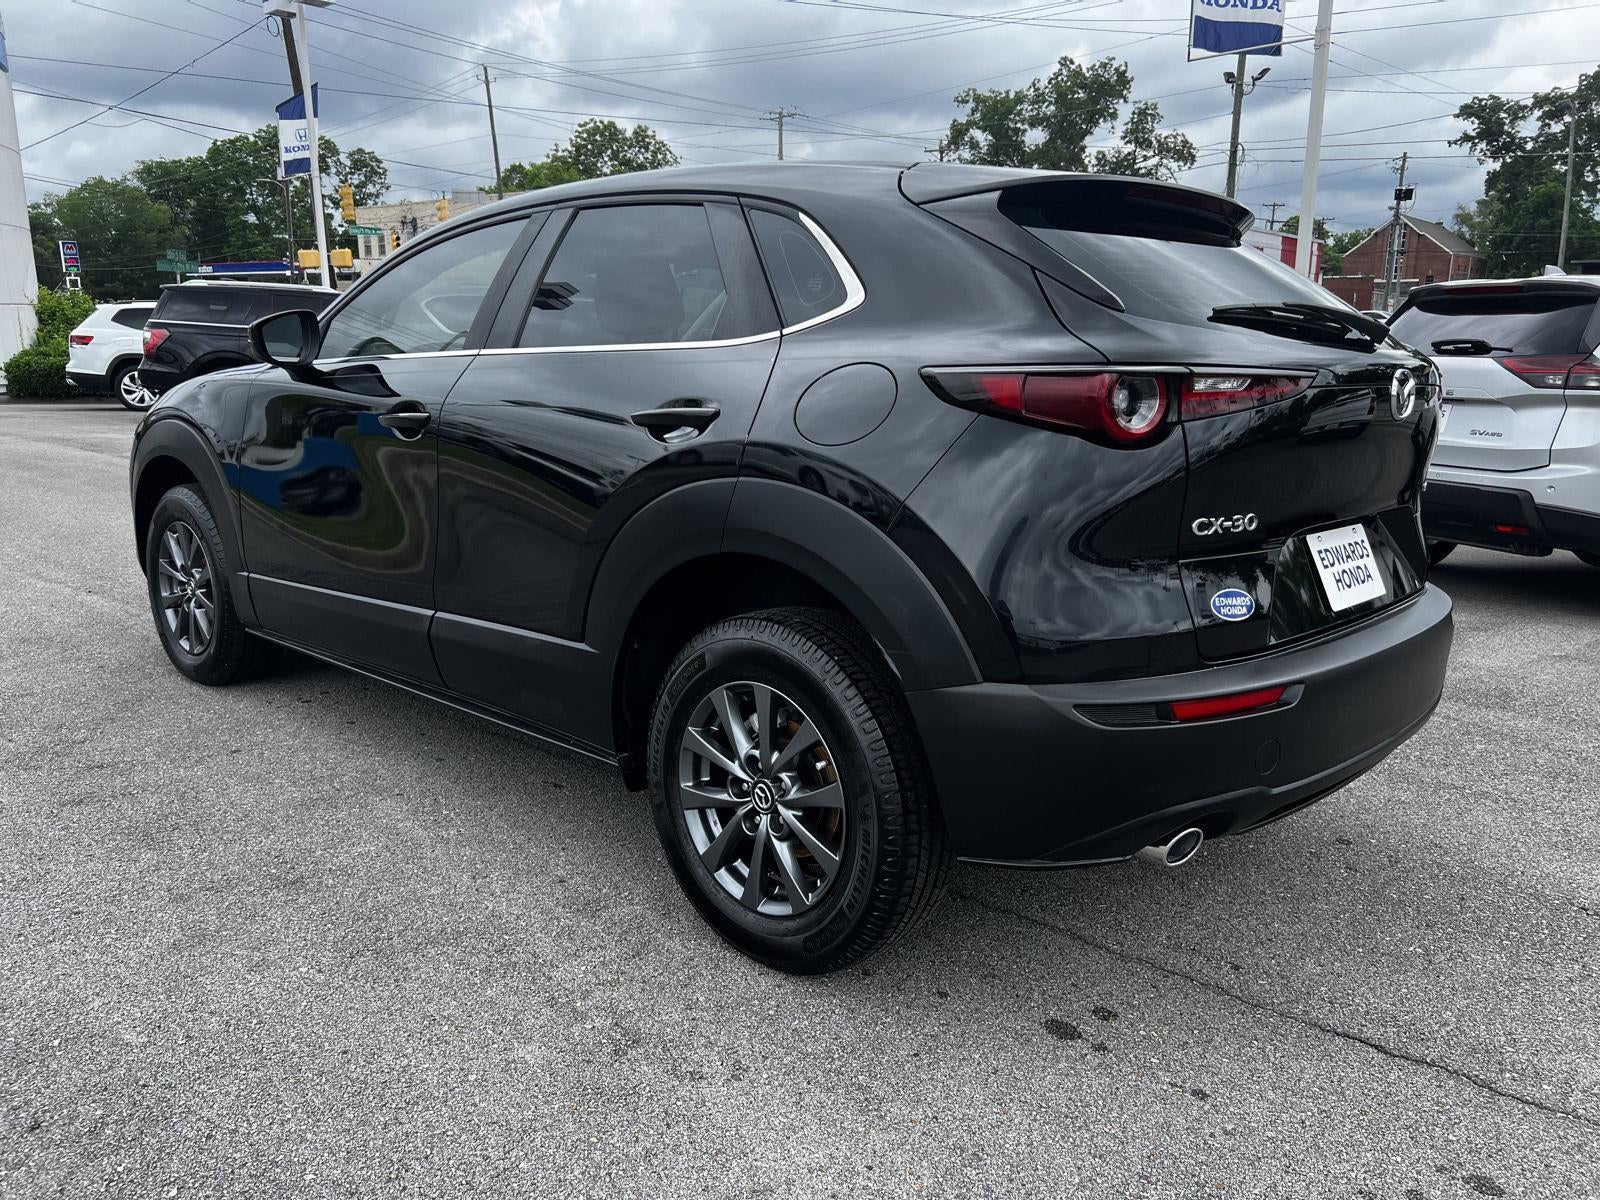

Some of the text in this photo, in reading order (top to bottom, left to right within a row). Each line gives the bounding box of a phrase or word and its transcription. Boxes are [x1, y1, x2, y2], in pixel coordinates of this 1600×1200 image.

[284, 144, 310, 154] HON
[1192, 513, 1259, 536] CX-30
[1317, 539, 1370, 570] EDWARDS
[1332, 563, 1374, 592] HONDA
[1215, 596, 1251, 607] EDWARDS
[1220, 604, 1248, 615] HONDA
[652, 698, 672, 777] MICHELIN
[845, 829, 871, 915] MICHELIN
